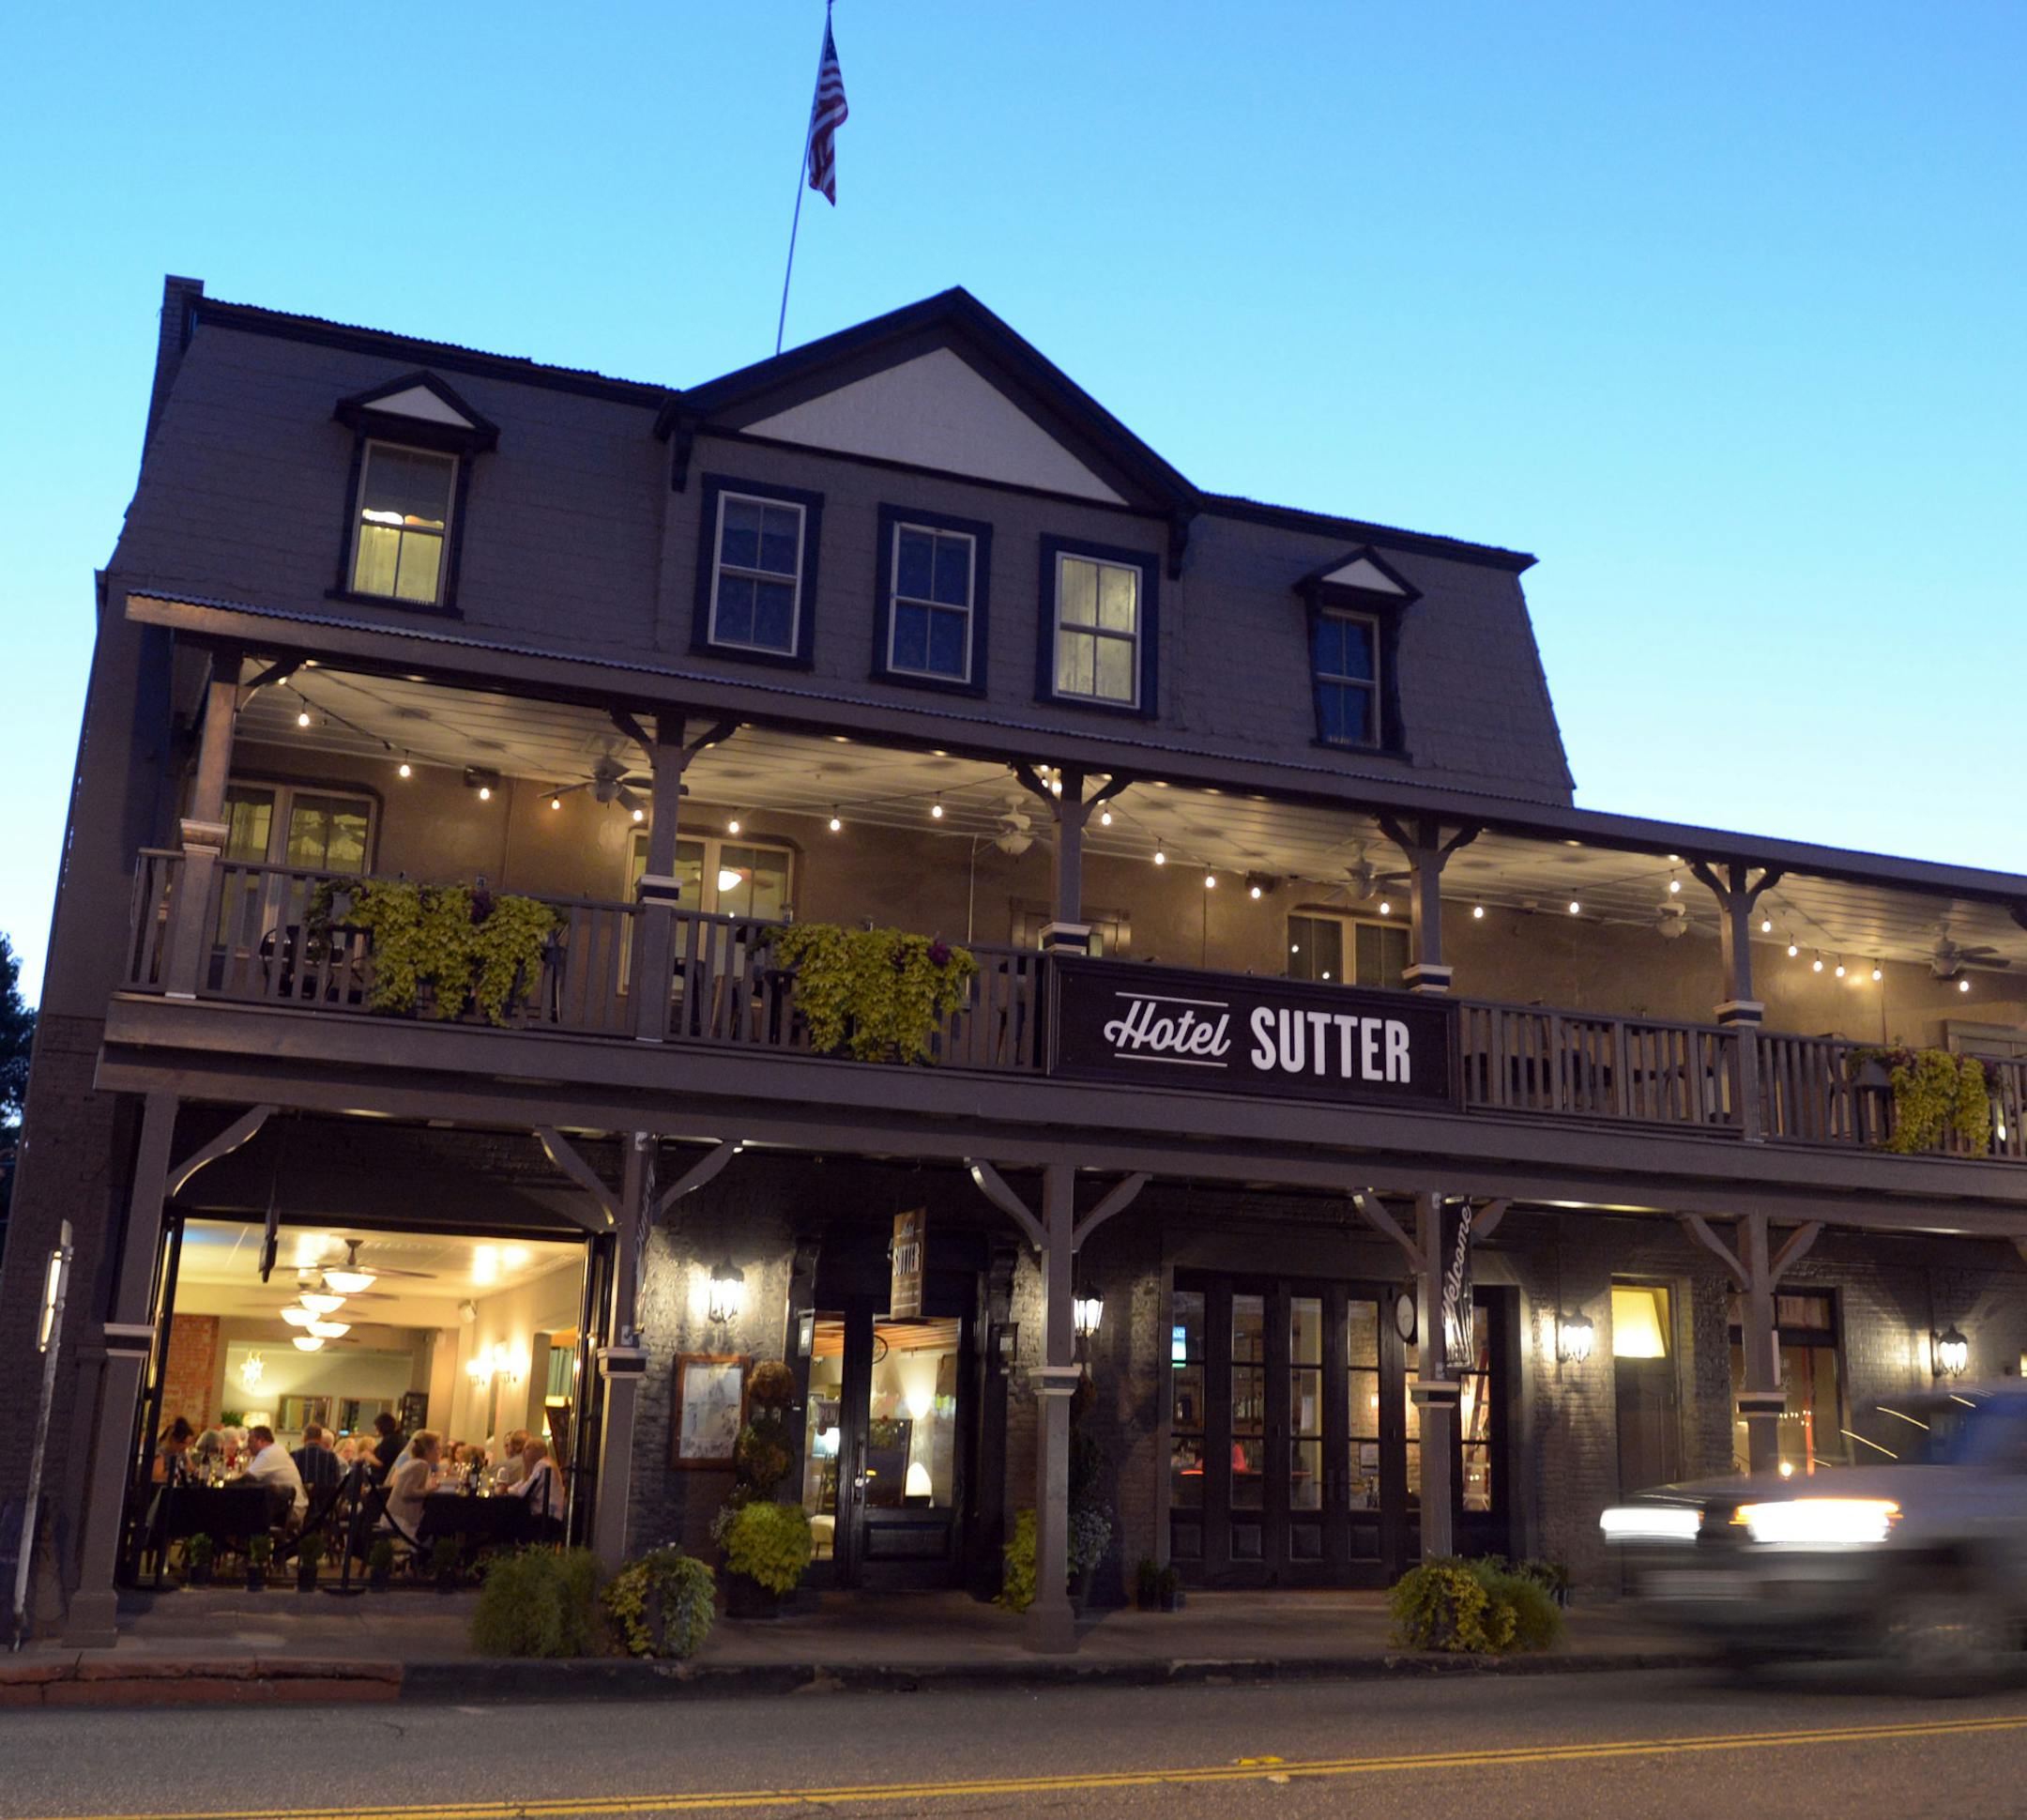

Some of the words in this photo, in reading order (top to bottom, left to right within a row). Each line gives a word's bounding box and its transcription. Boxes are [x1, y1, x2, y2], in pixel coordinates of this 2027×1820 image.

[1105, 1000, 1231, 1056] Hotel
[1251, 1006, 1410, 1083] SUTTER
[892, 1242, 921, 1277] SUTTER
[1441, 1204, 1471, 1329] Welcome
